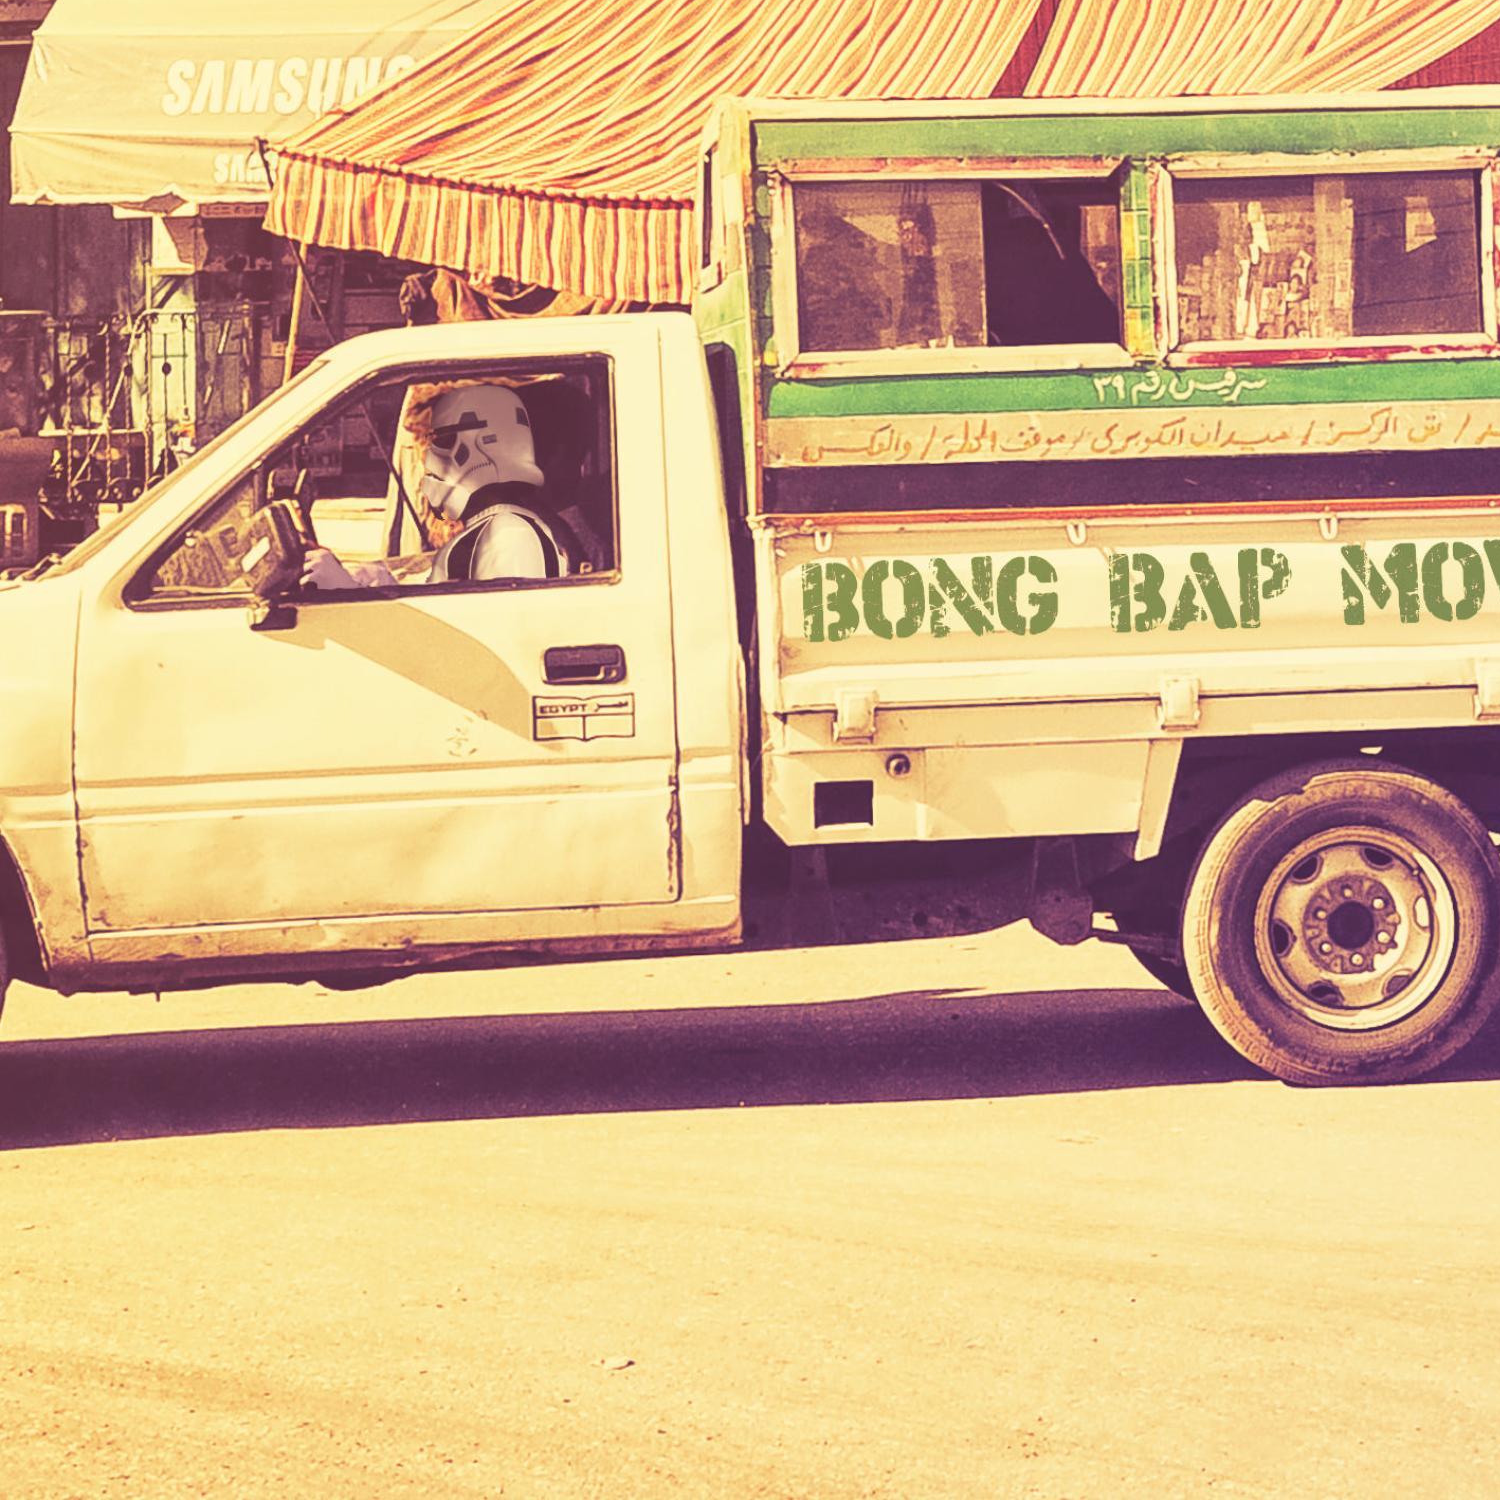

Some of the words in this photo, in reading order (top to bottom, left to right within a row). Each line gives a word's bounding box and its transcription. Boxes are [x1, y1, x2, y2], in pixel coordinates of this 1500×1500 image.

[999, 426, 1066, 458] موقف
[1190, 419, 1291, 452] ميدان
[801, 555, 1059, 643] BONG
[1108, 547, 1293, 633] BAP
[539, 704, 587, 714] EGYPT
